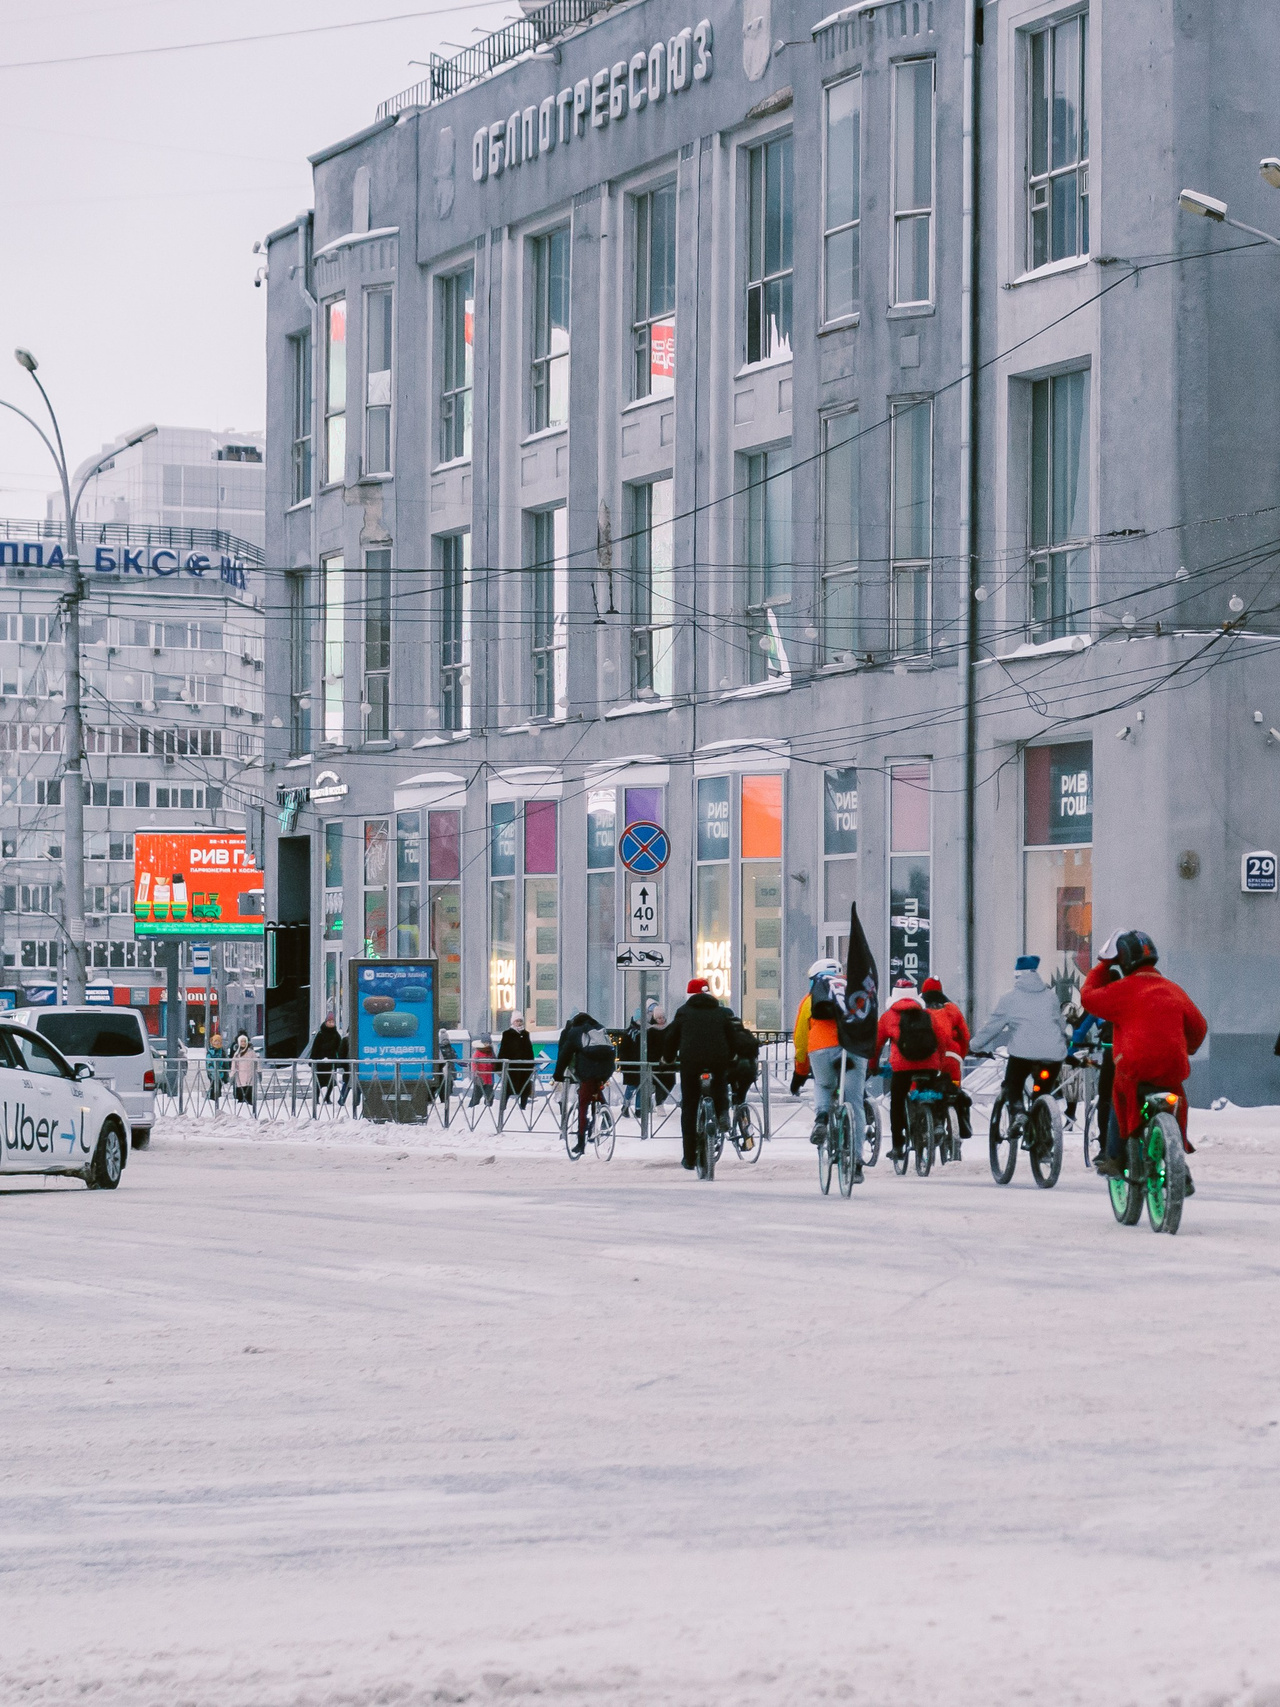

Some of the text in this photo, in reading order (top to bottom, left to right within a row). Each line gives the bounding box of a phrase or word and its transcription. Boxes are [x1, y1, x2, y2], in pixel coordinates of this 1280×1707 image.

[472, 17, 713, 183] ОБЛПОТРЕБСОЮЗ
[95, 545, 178, 577] БКС
[1061, 773, 1088, 795] РИВ
[707, 801, 729, 819] РИВ
[1061, 796, 1087, 817] ГОШ
[707, 821, 729, 839] ГОШ
[190, 849, 229, 864] РИВ
[1249, 859, 1274, 875] 29
[633, 907, 654, 921] 40
[380, 1046, 426, 1055] угадаете
[4, 1101, 59, 1153] Uber
